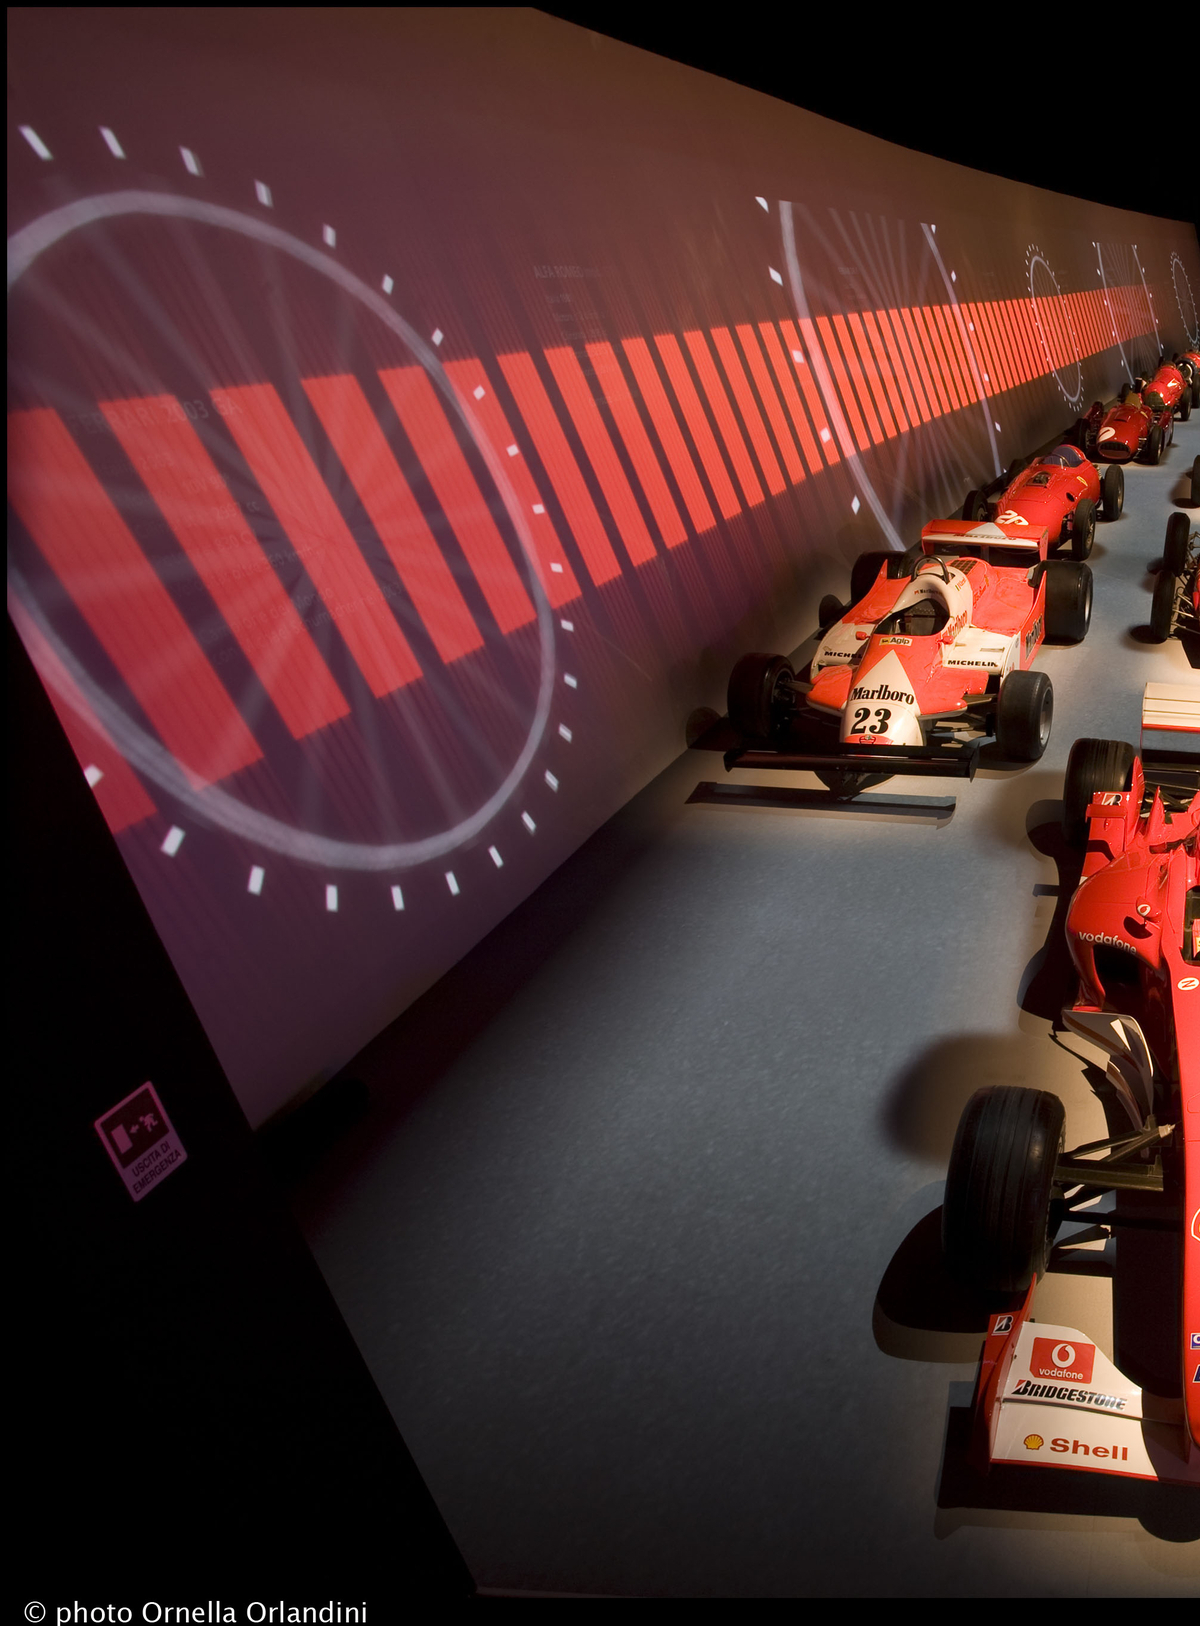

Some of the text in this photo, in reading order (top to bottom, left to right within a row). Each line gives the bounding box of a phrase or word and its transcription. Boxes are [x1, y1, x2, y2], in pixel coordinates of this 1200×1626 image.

[160, 399, 209, 423] 2003
[850, 684, 914, 705] Marlboro
[850, 708, 892, 734] 23
[1079, 931, 1137, 955] vodafone
[132, 1140, 171, 1177] USCITA DI
[132, 1149, 182, 1194] EMERGENZA
[1039, 1368, 1084, 1380] vodafone
[1011, 1379, 1128, 1411] BRIDGESTONE
[1050, 1438, 1129, 1461] Shell
